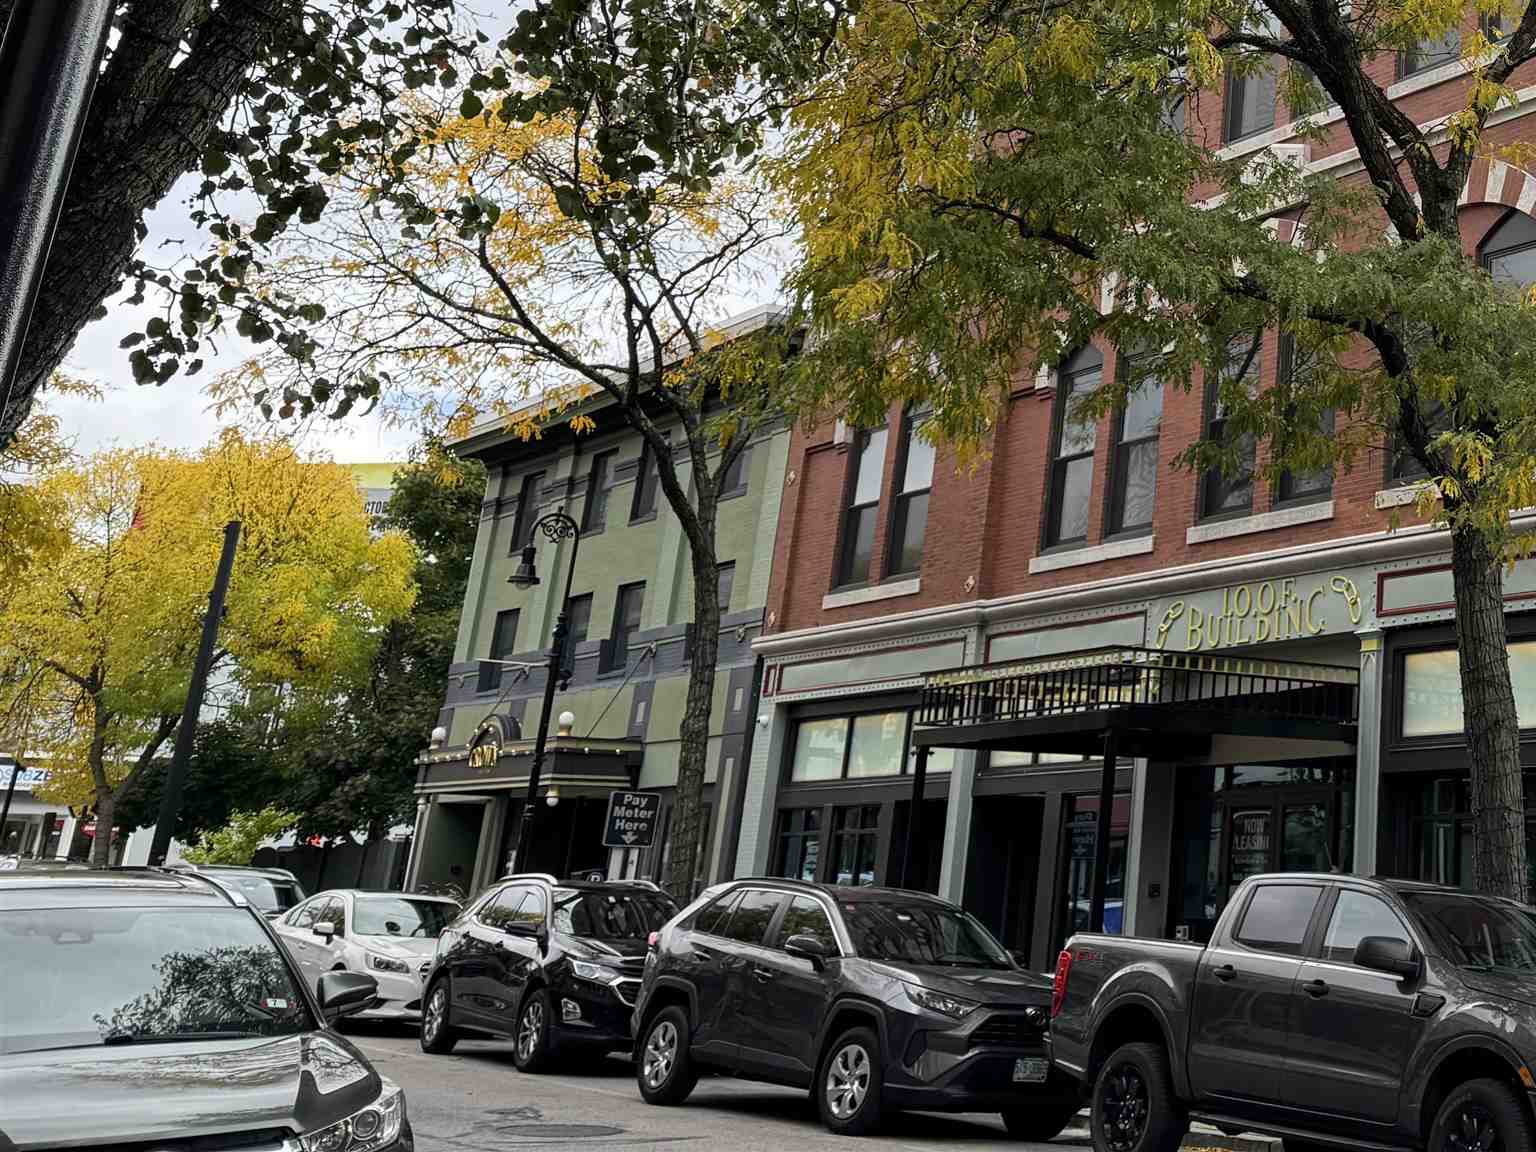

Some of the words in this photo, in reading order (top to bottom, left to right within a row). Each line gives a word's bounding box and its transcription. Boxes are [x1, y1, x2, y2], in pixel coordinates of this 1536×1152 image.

[1185, 584, 1327, 651] BUILDING
[623, 794, 648, 808] Pay
[613, 806, 655, 818] Meter
[614, 818, 648, 831] Here
